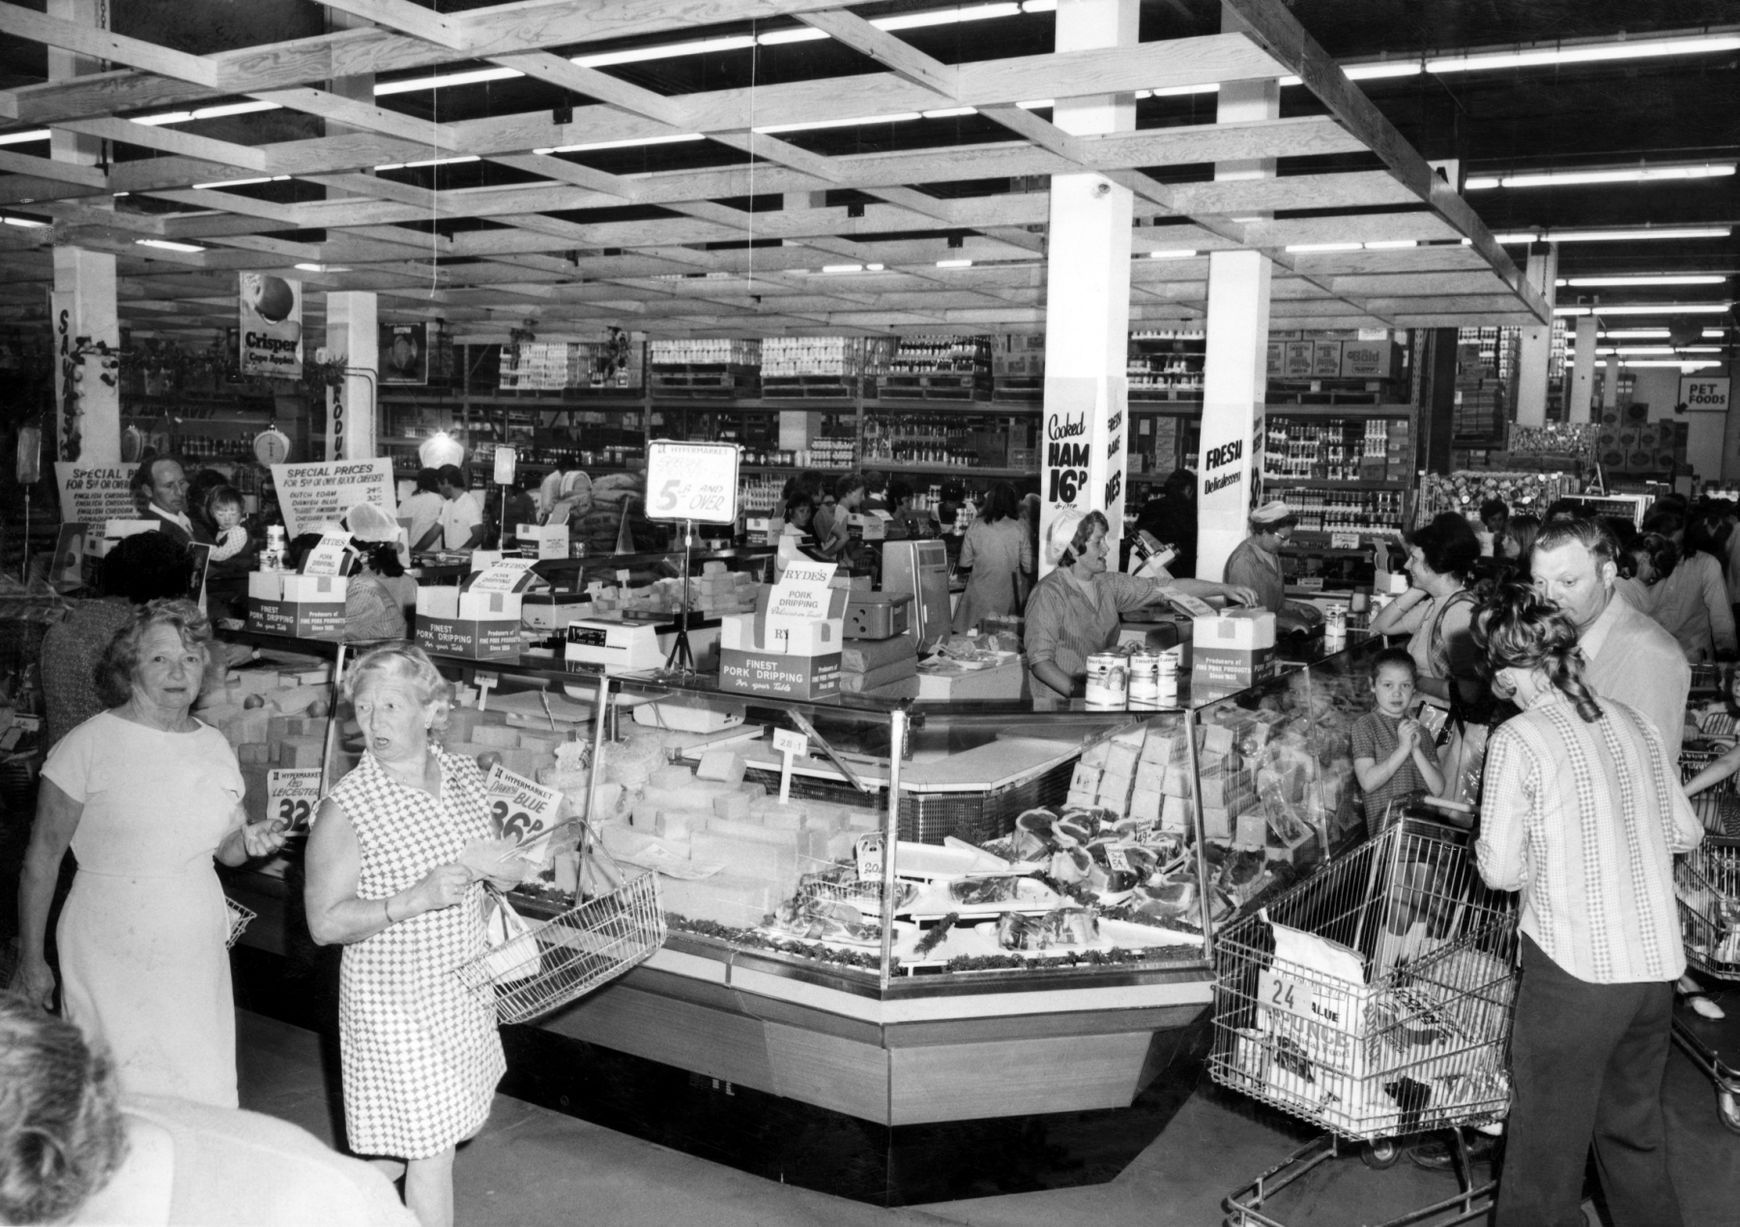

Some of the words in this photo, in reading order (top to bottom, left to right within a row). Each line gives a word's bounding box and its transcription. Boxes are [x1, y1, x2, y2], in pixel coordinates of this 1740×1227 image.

[246, 331, 297, 353] Crisper
[1690, 384, 1717, 394] PET
[1689, 395, 1726, 404] FOODS
[1048, 411, 1086, 441] Cooked
[1048, 442, 1090, 468] HAM
[1206, 439, 1242, 471] FRESH
[73, 469, 121, 479] SPECIAL
[287, 467, 330, 478] SPECIAL
[334, 464, 374, 475] PRICES
[65, 479, 83, 490] FOR
[689, 494, 725, 511] OVER
[785, 569, 827, 581] RYDE'S
[789, 590, 813, 599] PORK
[779, 599, 818, 609] DRIPPING
[267, 613, 294, 623] DRIPPING
[430, 624, 452, 633] FINEST
[416, 629, 434, 640] PORK
[438, 633, 472, 644] DRIPPING
[746, 659, 778, 671] FINEST
[1205, 657, 1234, 665] Producers
[723, 665, 750, 677] PORK
[757, 671, 803, 683] DRIPPING
[505, 774, 552, 800] HYPERMARKET
[513, 792, 548, 814] BLUE
[1272, 980, 1294, 1009] 24
